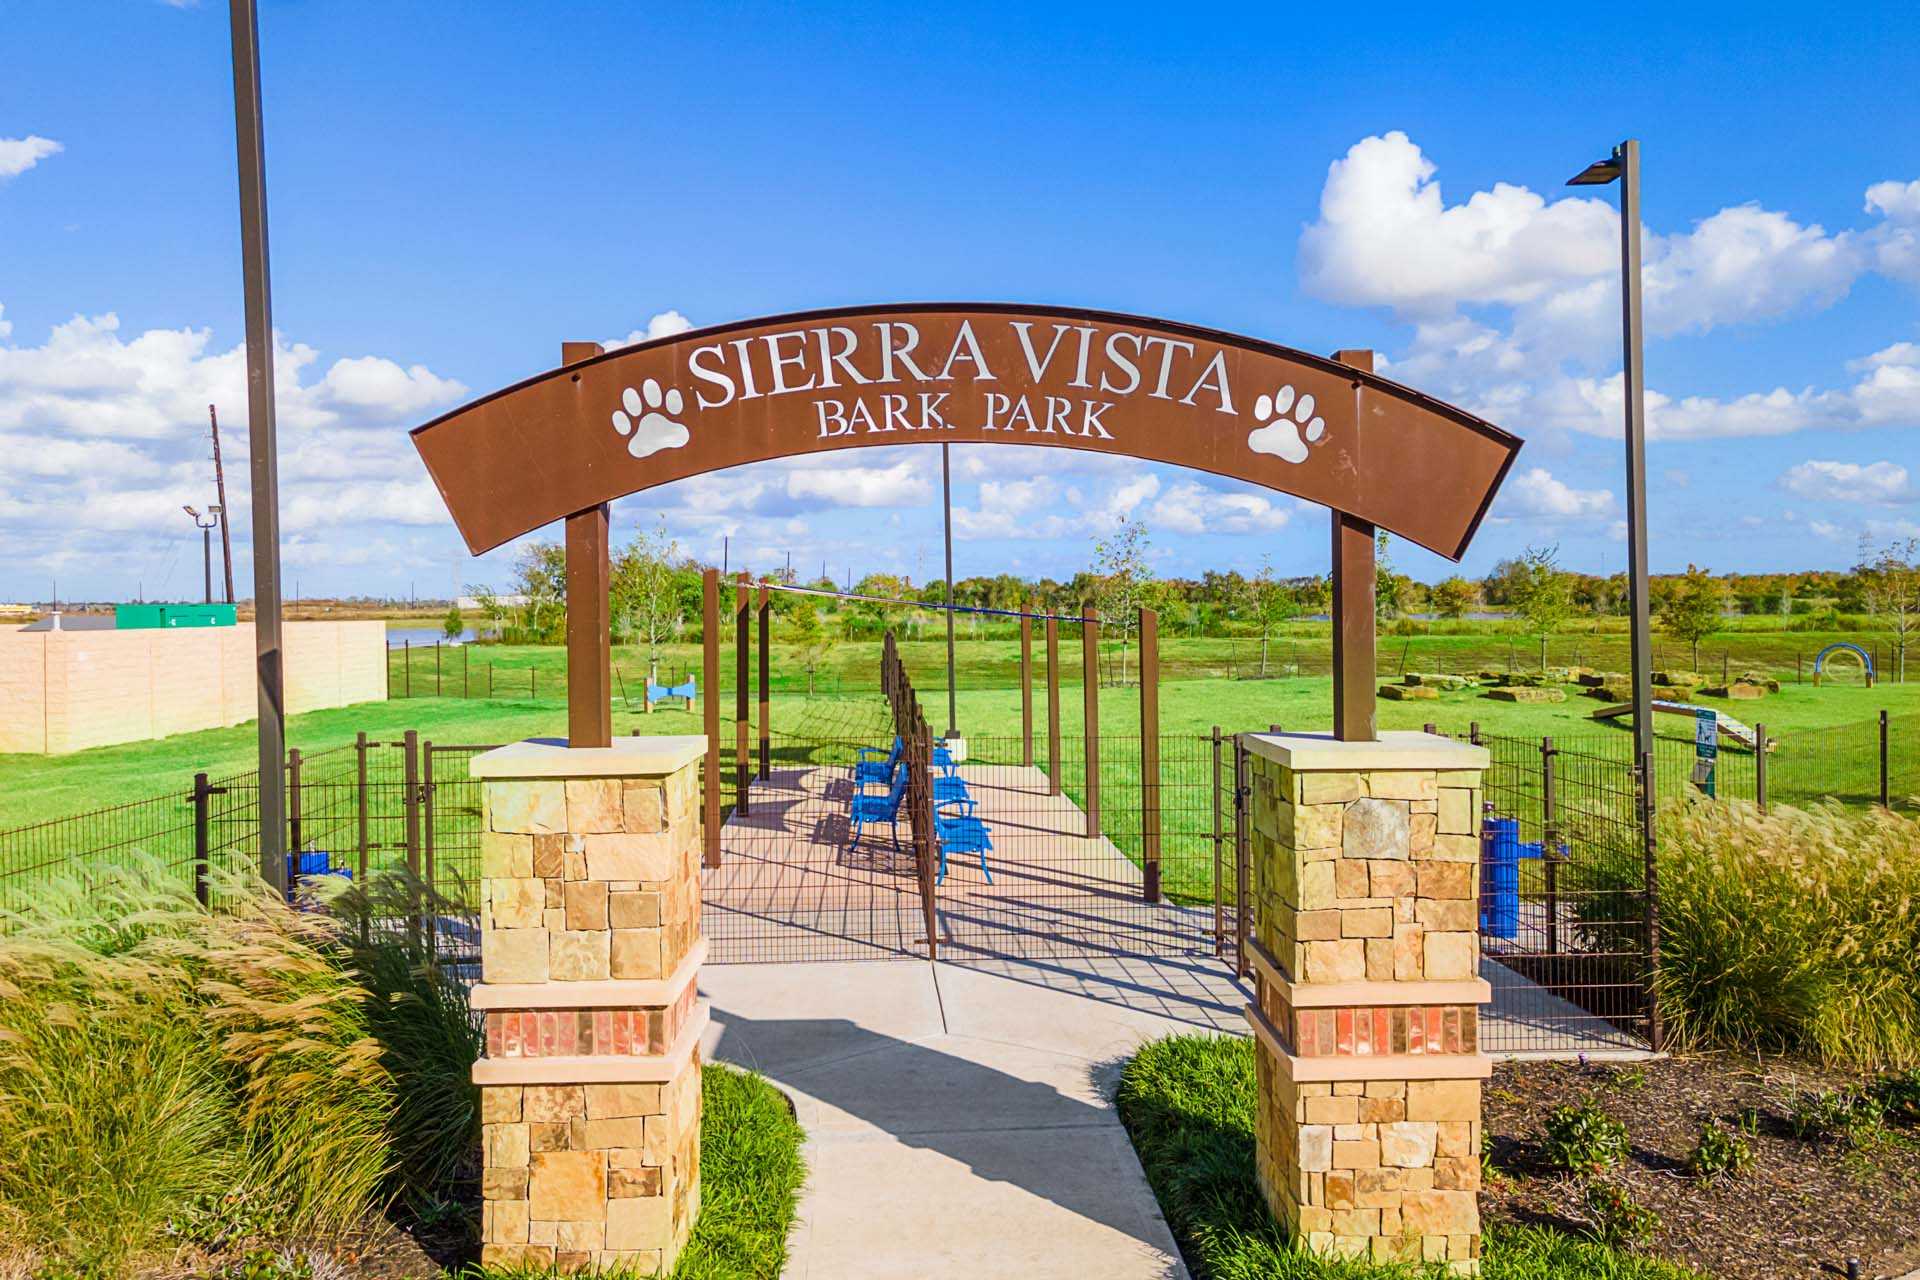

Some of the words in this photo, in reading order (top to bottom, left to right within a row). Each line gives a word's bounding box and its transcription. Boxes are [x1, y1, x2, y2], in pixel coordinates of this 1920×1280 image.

[688, 320, 998, 411] SIERRA
[1009, 322, 1238, 415] VISTA
[812, 392, 956, 438] BARK
[982, 392, 1115, 440] PARK
